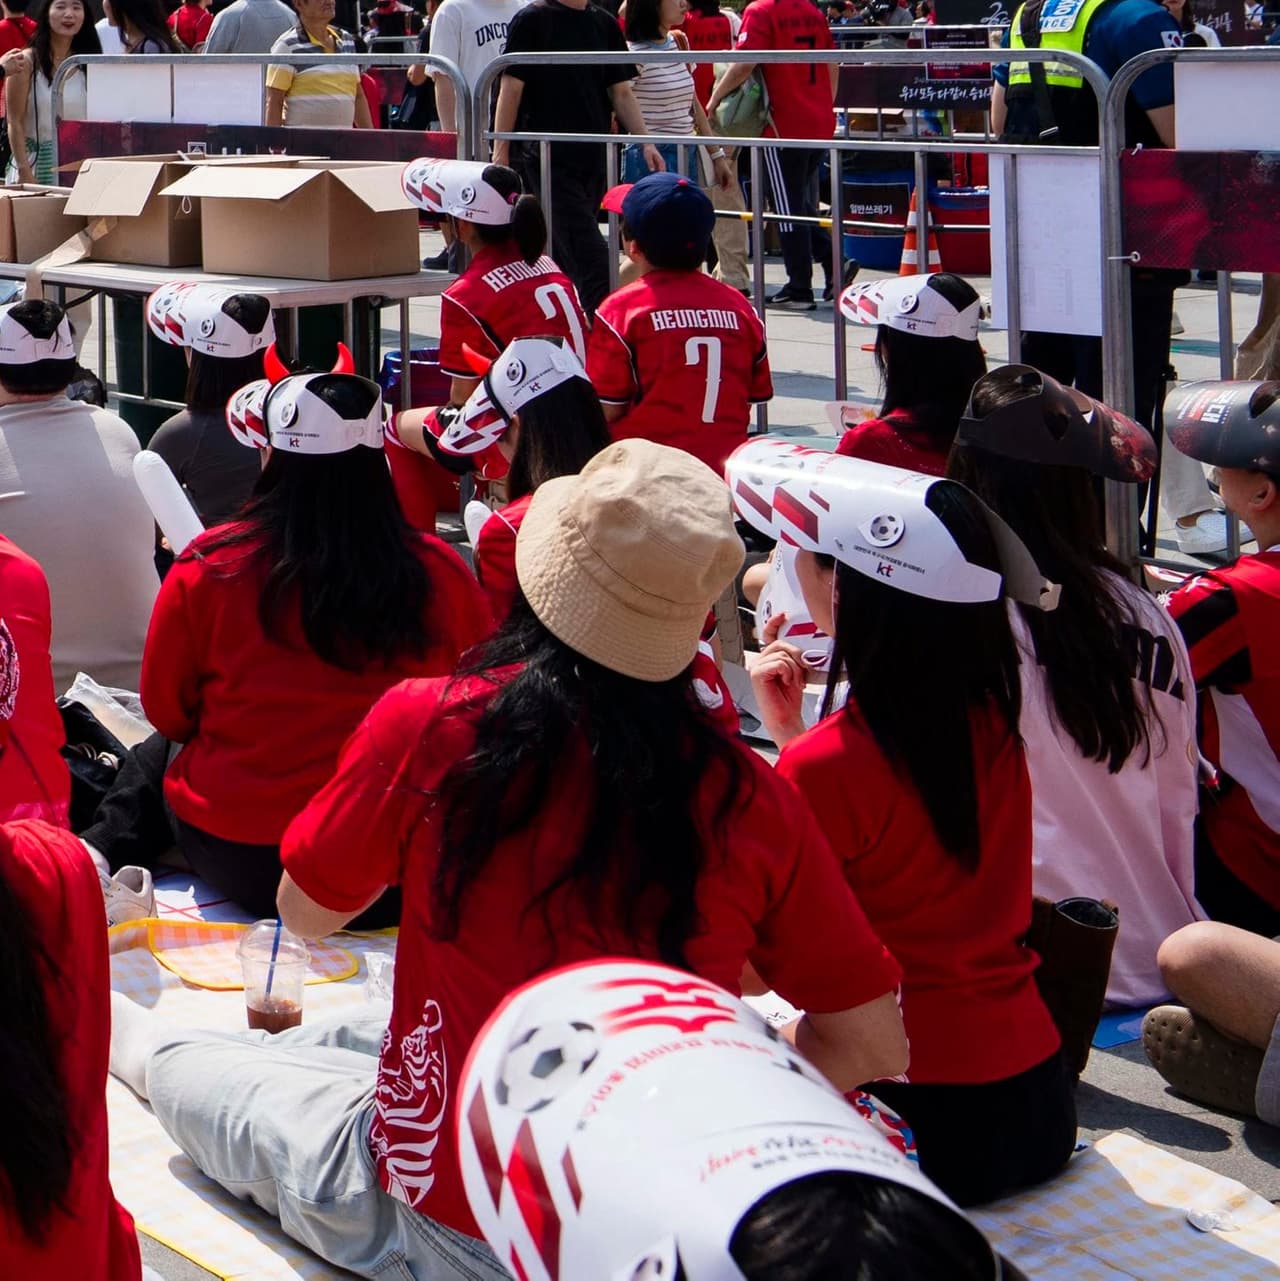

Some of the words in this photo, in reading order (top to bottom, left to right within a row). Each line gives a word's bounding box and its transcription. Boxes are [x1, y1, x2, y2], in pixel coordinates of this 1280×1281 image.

[850, 204, 893, 215] 일반쓰레기
[649, 309, 740, 332] HEUNGMIN
[906, 321, 917, 331] kt
[205, 343, 215, 353] kt
[684, 336, 722, 424] 7
[529, 381, 541, 393] kt
[289, 437, 301, 448] kt
[876, 561, 894, 578] kt
